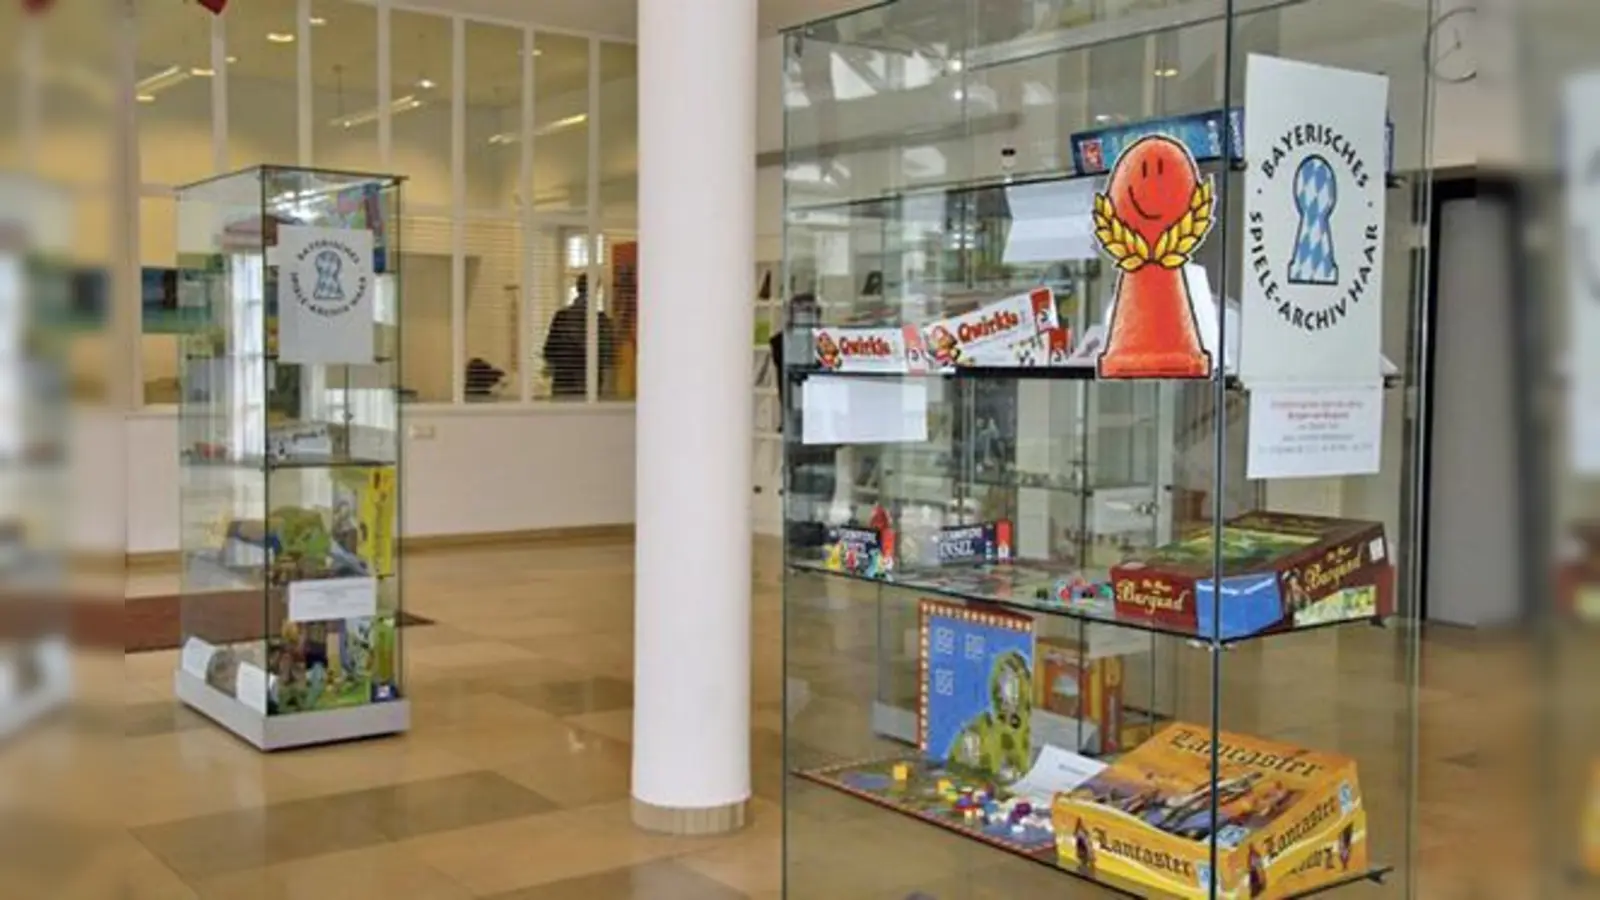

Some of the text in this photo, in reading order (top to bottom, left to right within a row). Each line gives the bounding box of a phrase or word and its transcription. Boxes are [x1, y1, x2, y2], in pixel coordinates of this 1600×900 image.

[1261, 123, 1371, 188] BAYERISCHES
[1249, 211, 1378, 331] SPIELE-ARCHIV HAAR
[1091, 827, 1192, 878] Lancaster
[1263, 795, 1336, 859] Lancaster
